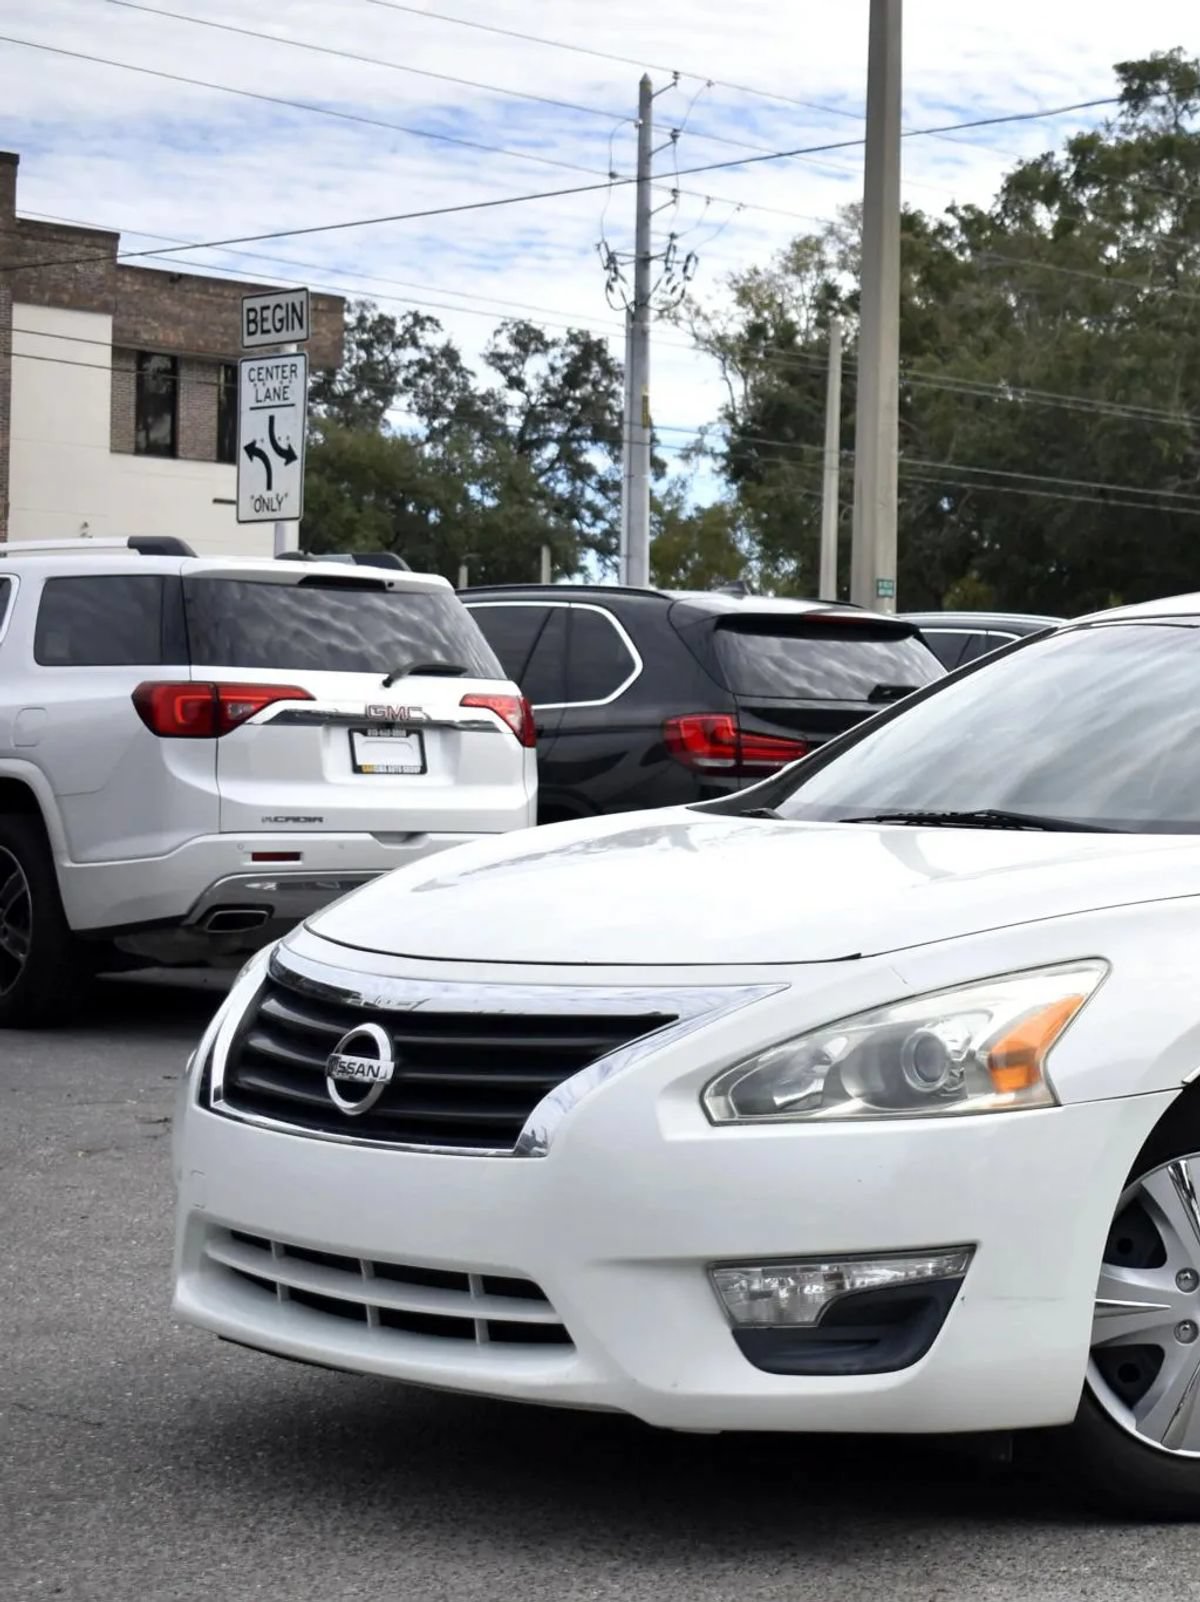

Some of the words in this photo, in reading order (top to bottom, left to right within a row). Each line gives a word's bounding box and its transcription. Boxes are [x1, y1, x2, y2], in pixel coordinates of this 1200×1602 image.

[246, 300, 304, 336] BEGIN
[248, 363, 298, 383] CENTER
[255, 385, 290, 404] LANE
[254, 496, 285, 513] ONLY
[366, 704, 425, 721] GMC
